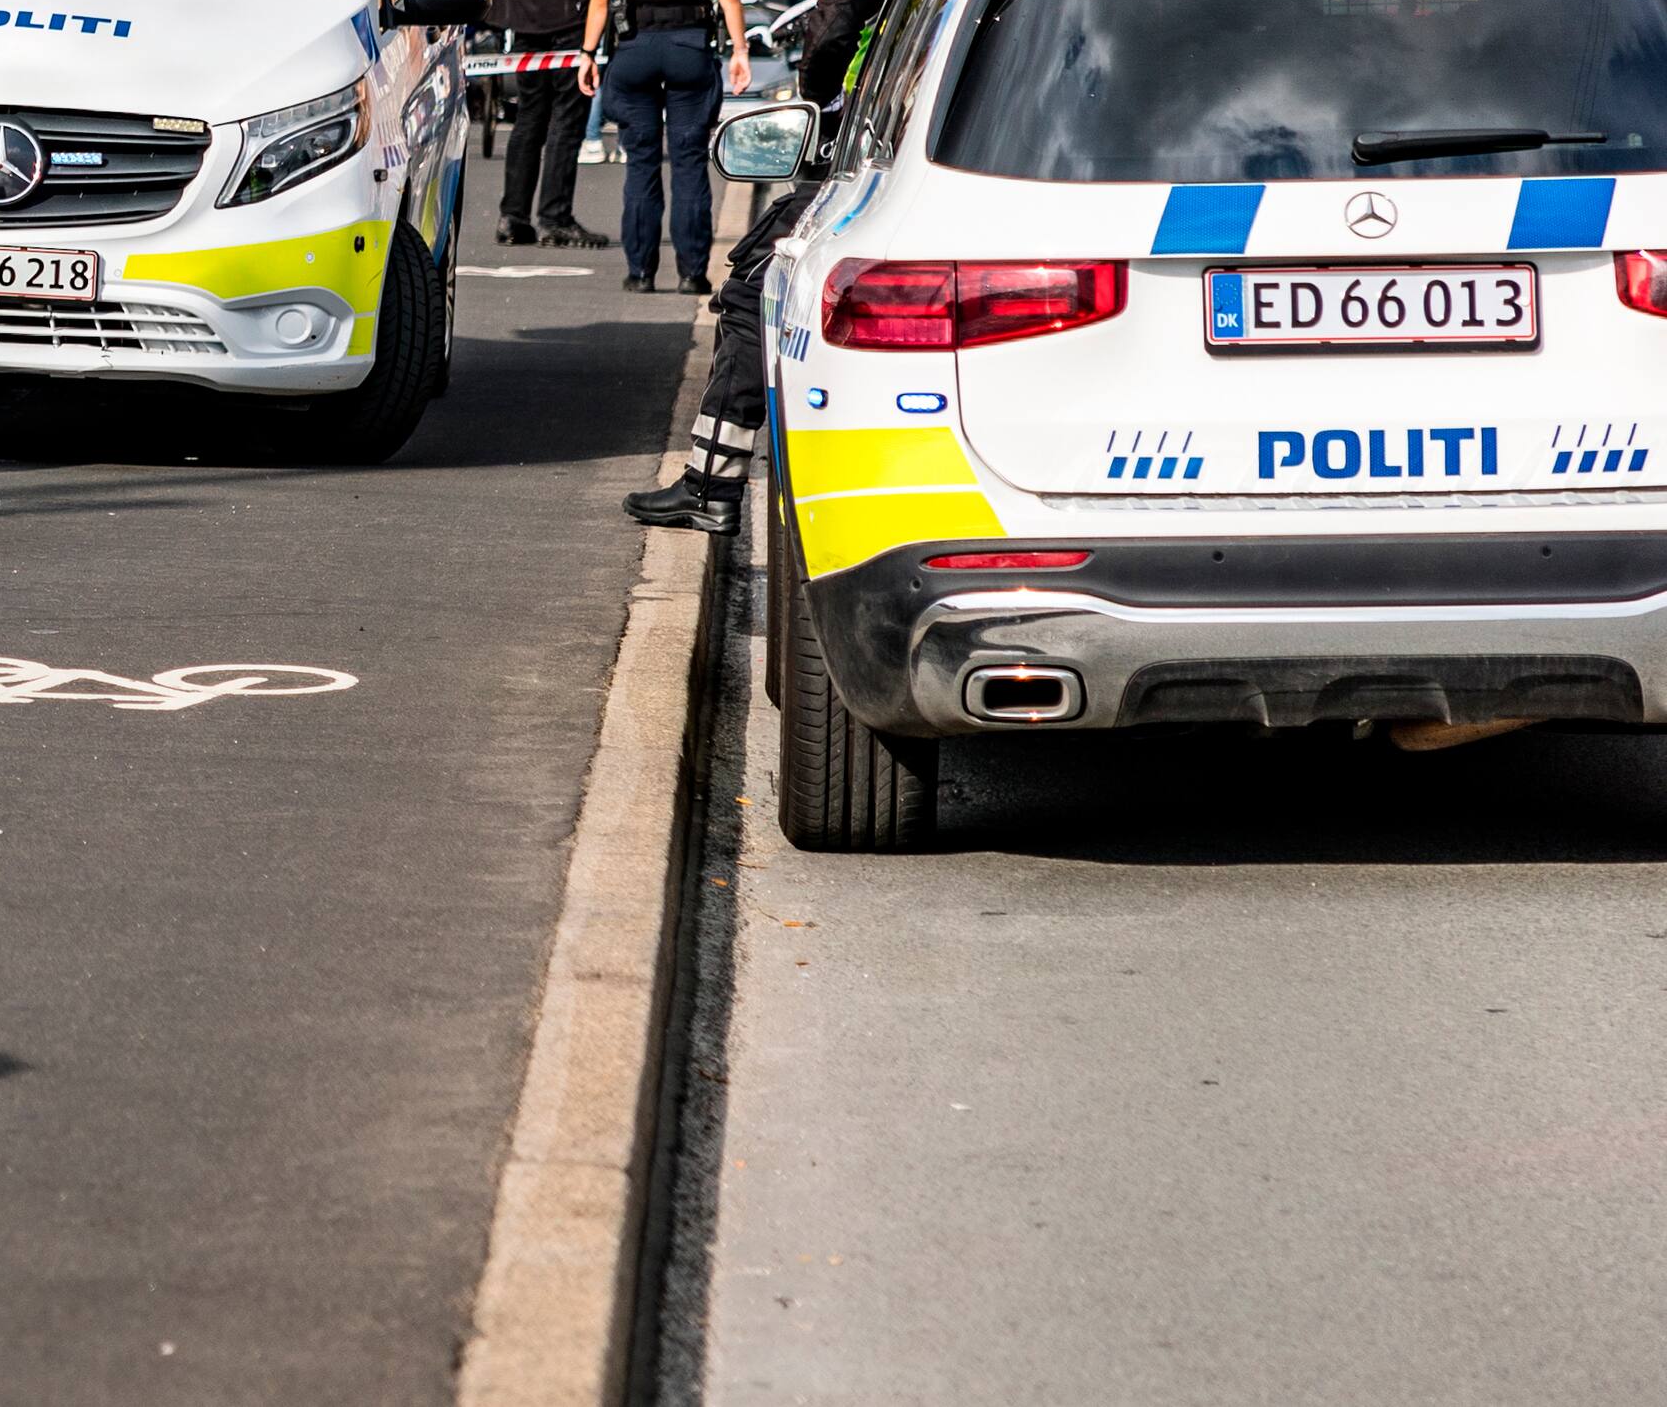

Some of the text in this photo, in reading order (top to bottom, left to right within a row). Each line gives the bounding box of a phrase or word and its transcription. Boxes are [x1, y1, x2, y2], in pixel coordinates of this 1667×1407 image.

[25, 258, 90, 291] 218
[1217, 278, 1525, 329] DK ED 66 013
[1258, 427, 1498, 479] POLITI
